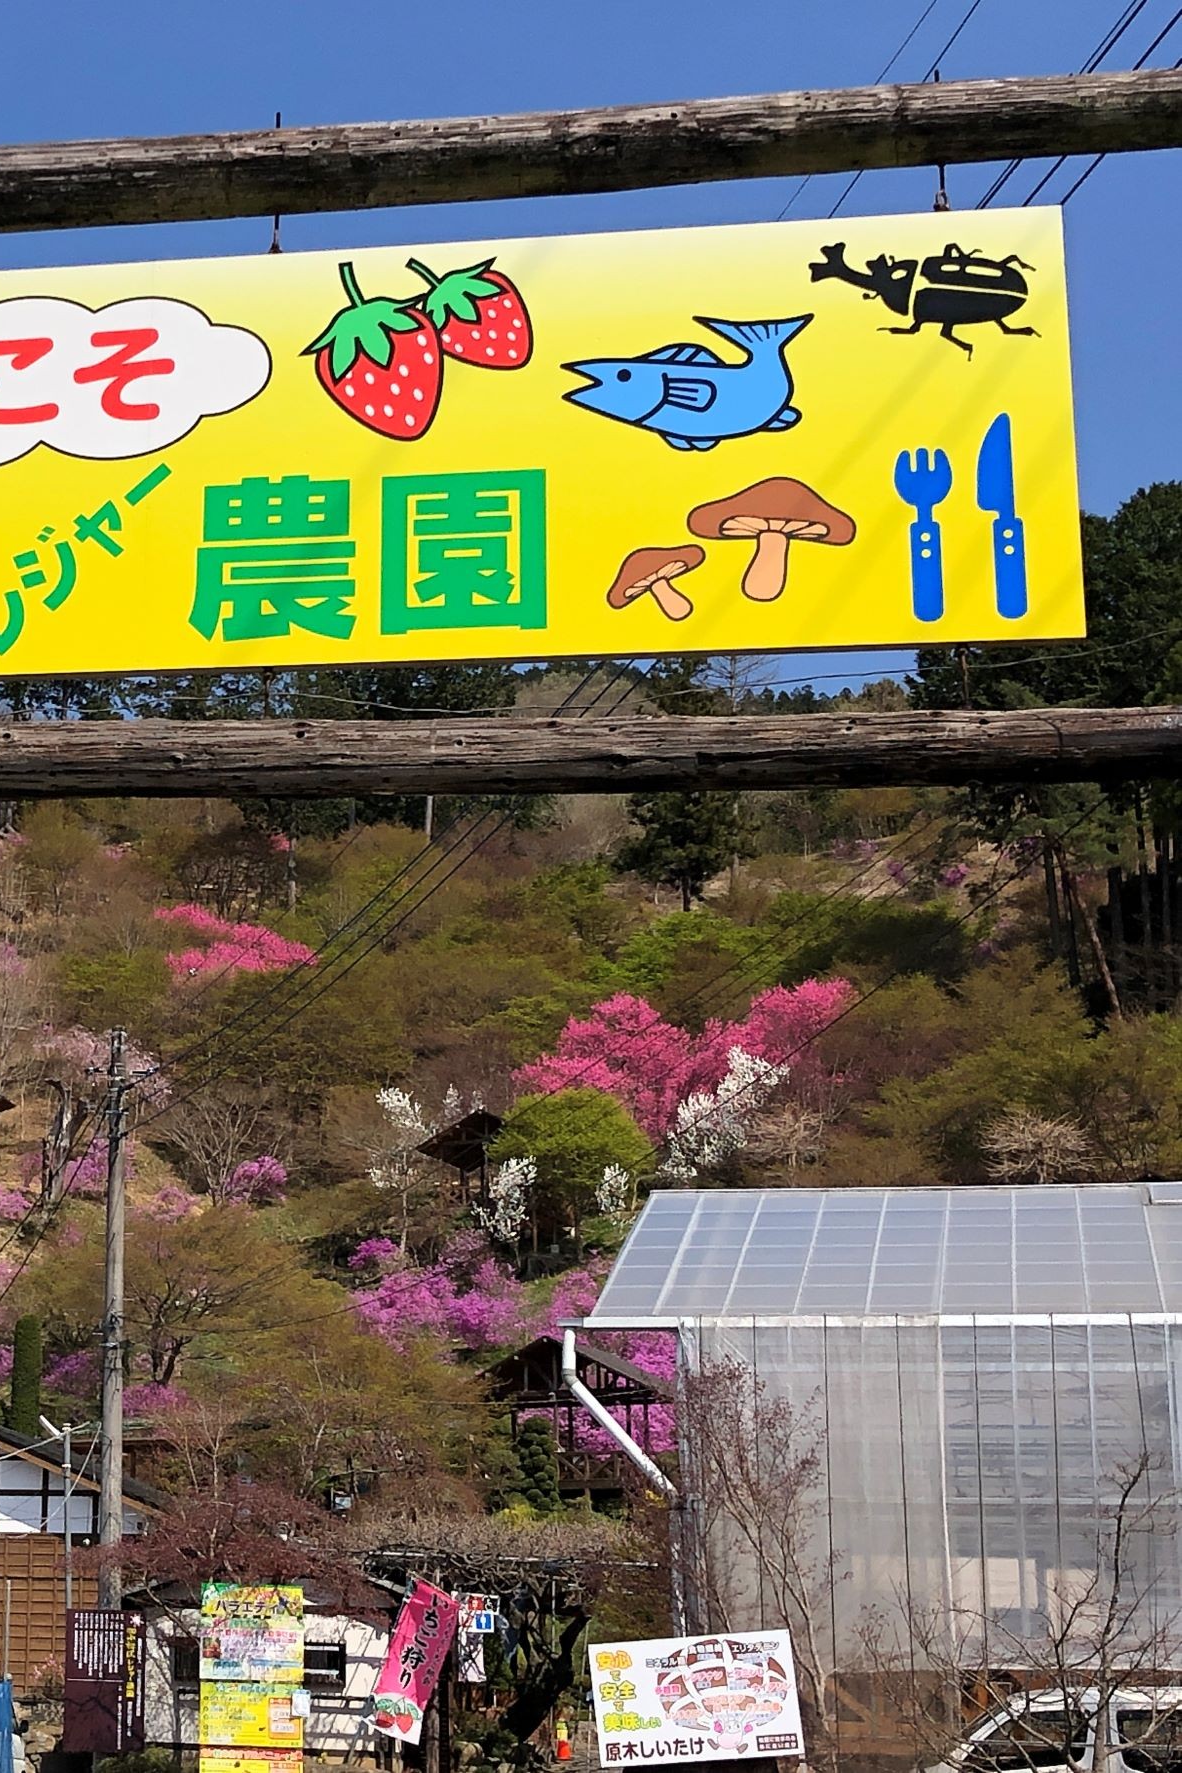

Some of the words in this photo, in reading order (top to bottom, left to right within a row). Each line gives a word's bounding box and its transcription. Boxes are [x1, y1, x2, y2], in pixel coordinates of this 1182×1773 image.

[400, 1593, 450, 1690] いちご狩り
[595, 1650, 633, 1671] 安心
[599, 1680, 637, 1702] 安全
[603, 1712, 662, 1733] 美味しい
[605, 1737, 706, 1762] 原木しいたけ
